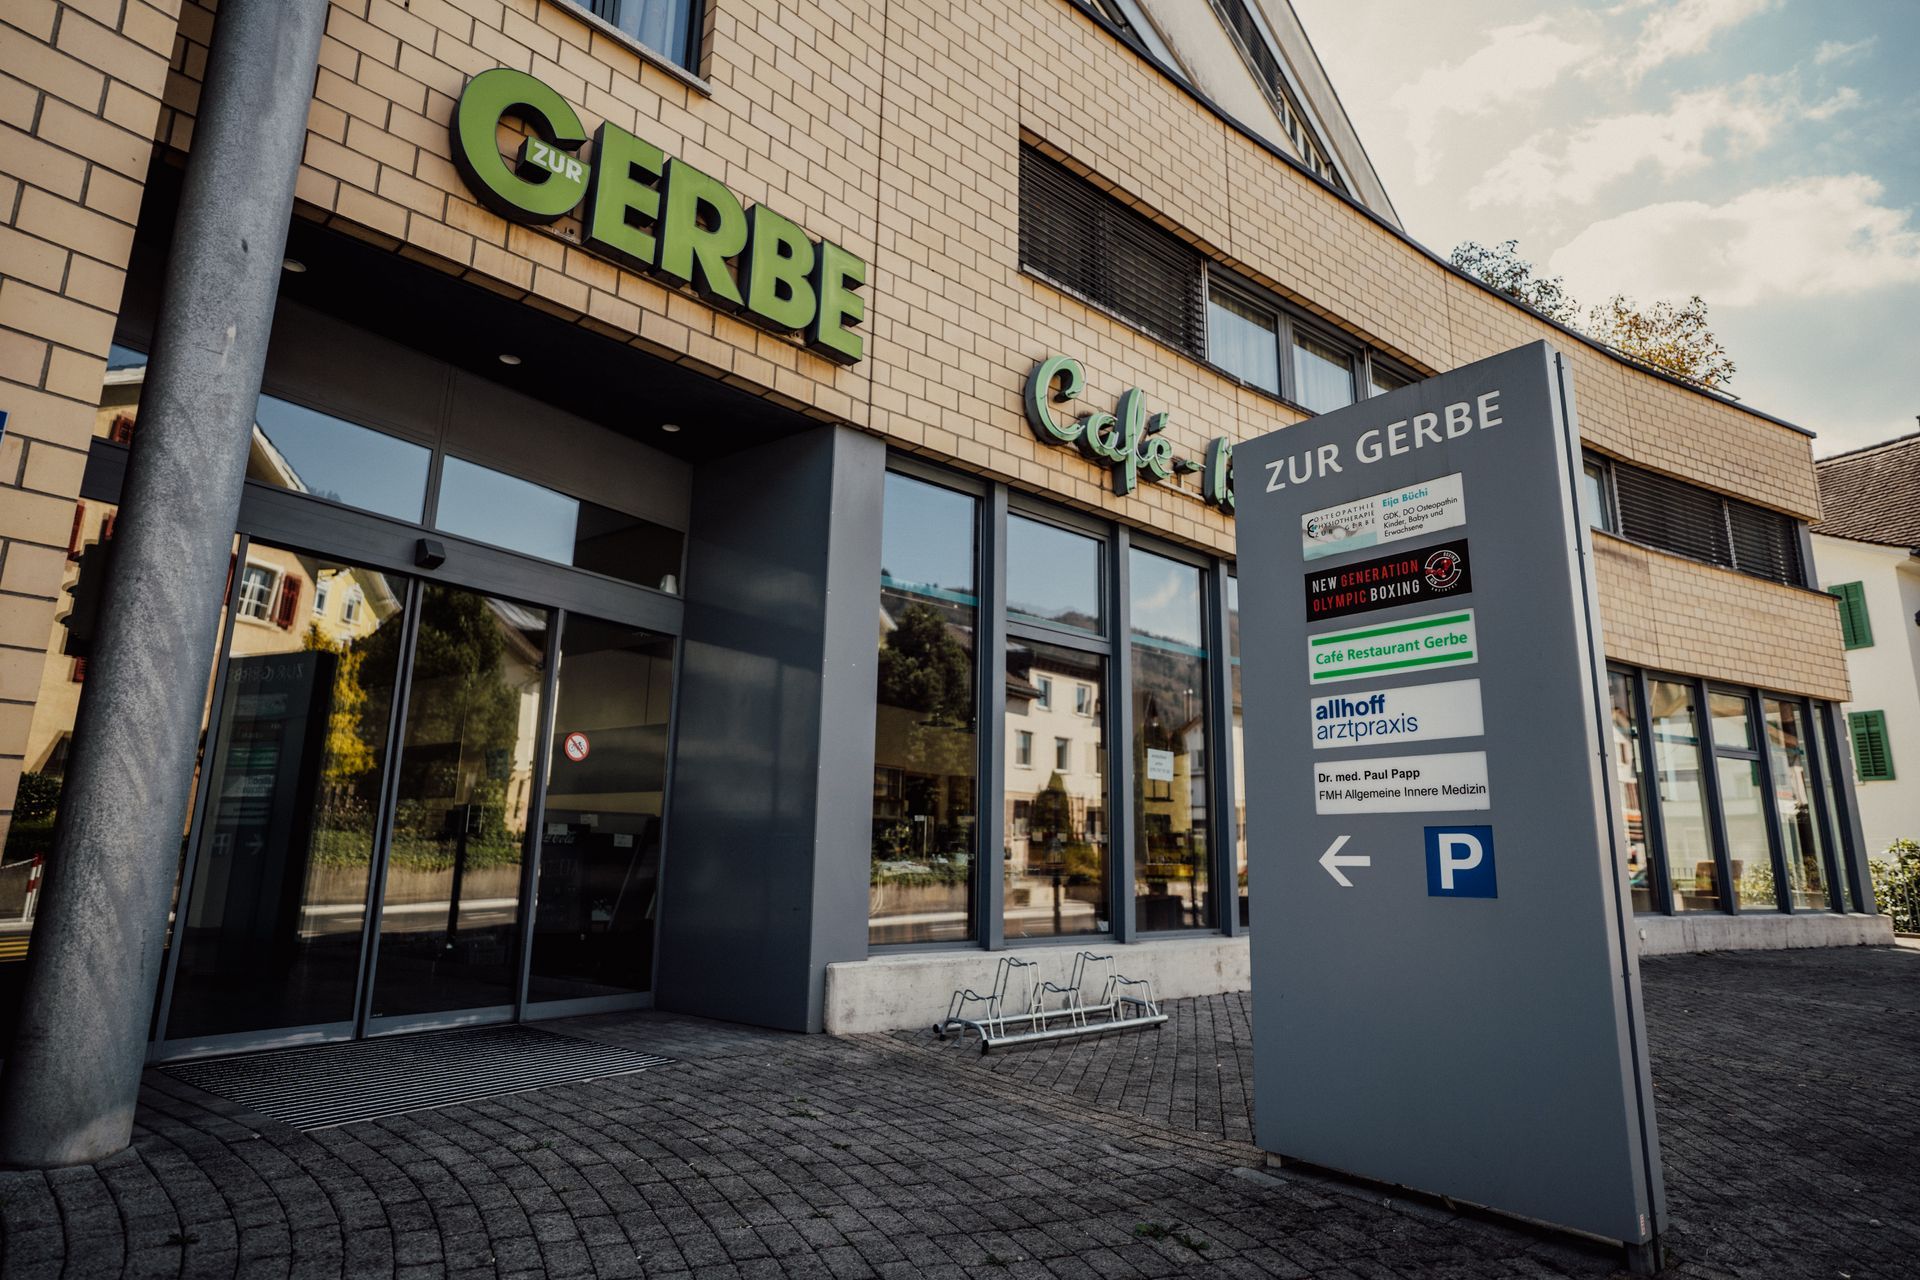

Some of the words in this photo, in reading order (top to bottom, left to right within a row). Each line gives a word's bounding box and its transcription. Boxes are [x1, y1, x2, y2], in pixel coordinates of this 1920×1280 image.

[532, 142, 583, 184] ZUR
[452, 67, 866, 365] GERBE
[1265, 443, 1343, 493] ZUR
[1355, 390, 1503, 464] GERBE
[1382, 497, 1399, 508] Eija
[1402, 488, 1429, 502] Büchi
[1383, 511, 1401, 522] GDK,
[1402, 507, 1415, 516] DO
[1416, 497, 1458, 513] Osteopathin
[1313, 502, 1374, 523] OSTEOPATHIE
[1314, 510, 1375, 530] PHYSIOTHERAPIE
[1384, 519, 1407, 529] Kinder,
[1408, 513, 1429, 523] Babys
[1430, 508, 1444, 518] und
[1384, 523, 1424, 538] Erwachsene
[1312, 576, 1337, 594] NEW
[1340, 560, 1419, 588] GENERATION
[1313, 590, 1367, 613] OLYMPIC
[1370, 579, 1420, 602] BOXING
[1315, 650, 1344, 666] Café
[1347, 639, 1420, 661] Restaurant
[1424, 632, 1468, 649] Gerbe
[1315, 694, 1386, 720] allhoff
[1316, 712, 1419, 742] arztpraxis
[1318, 772, 1333, 783] Dr.
[1335, 770, 1361, 783] med.
[1363, 769, 1388, 781] Paul
[1391, 768, 1420, 781] Papp
[1319, 789, 1343, 801] FMH
[1344, 787, 1401, 802] Allgemeine
[1404, 785, 1439, 797] Innere
[1441, 782, 1486, 796] Medizin
[1438, 833, 1483, 890] P
